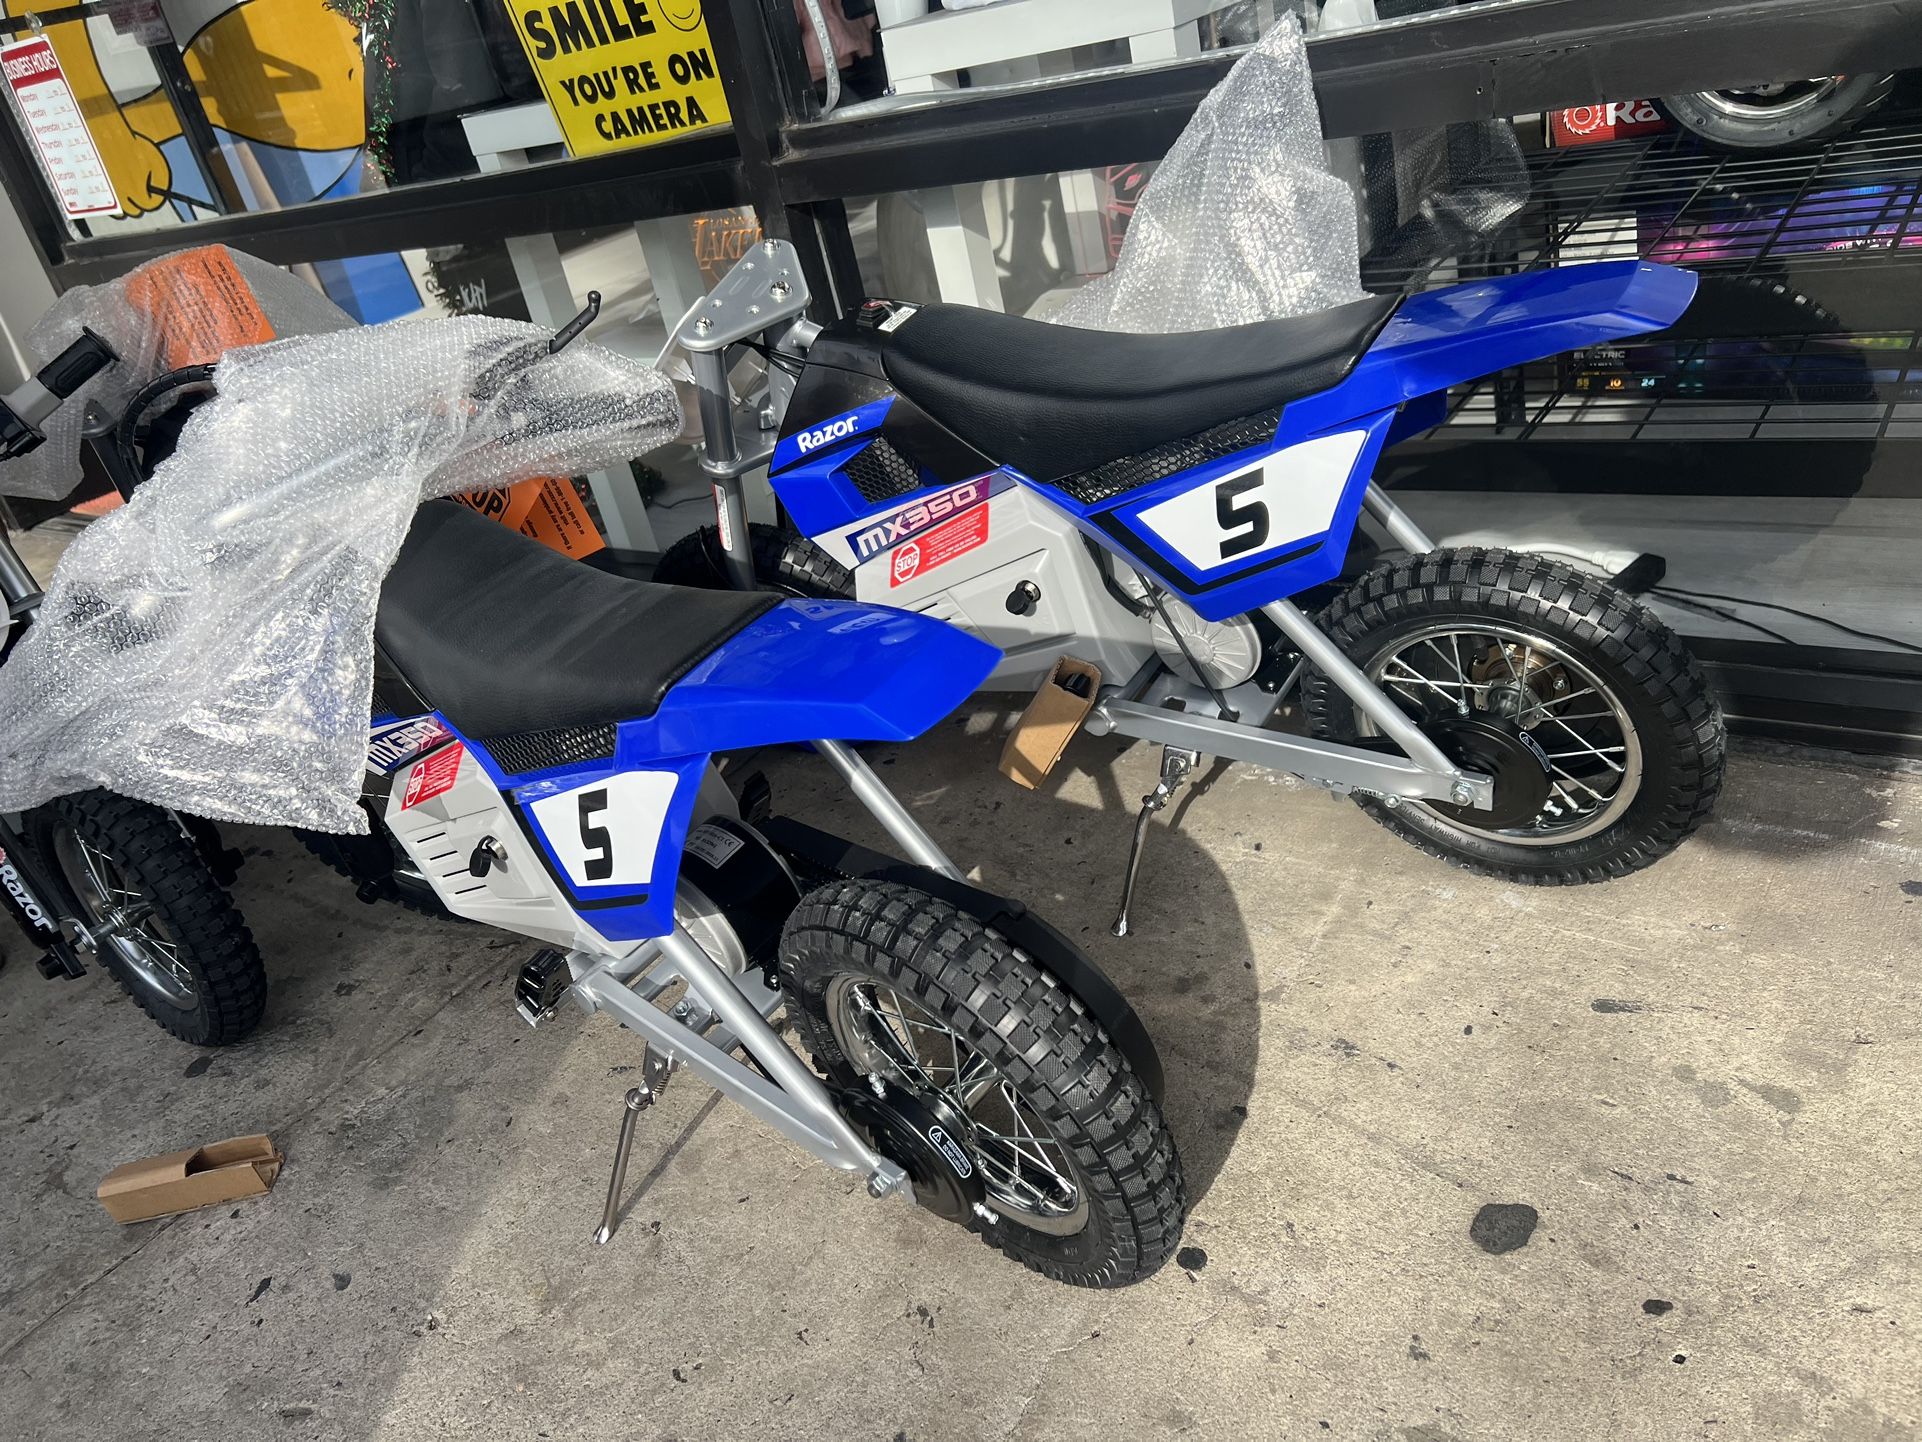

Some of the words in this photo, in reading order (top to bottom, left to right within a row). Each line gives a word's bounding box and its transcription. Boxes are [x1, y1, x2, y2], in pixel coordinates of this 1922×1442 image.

[524, 0, 656, 61] SMILE
[4, 55, 36, 80] BUSINESS
[30, 49, 57, 73] HOURS
[559, 61, 660, 107] YOU'RE
[668, 48, 715, 86] ON
[594, 96, 709, 142] CAMERA
[1641, 378, 1655, 387] 24
[797, 415, 859, 453] Razor
[856, 484, 978, 557] MX350
[1214, 467, 1270, 559] 5
[896, 553, 918, 572] STOP
[368, 721, 443, 767] MX350
[577, 787, 613, 881] 5
[0, 864, 53, 932] Razor
